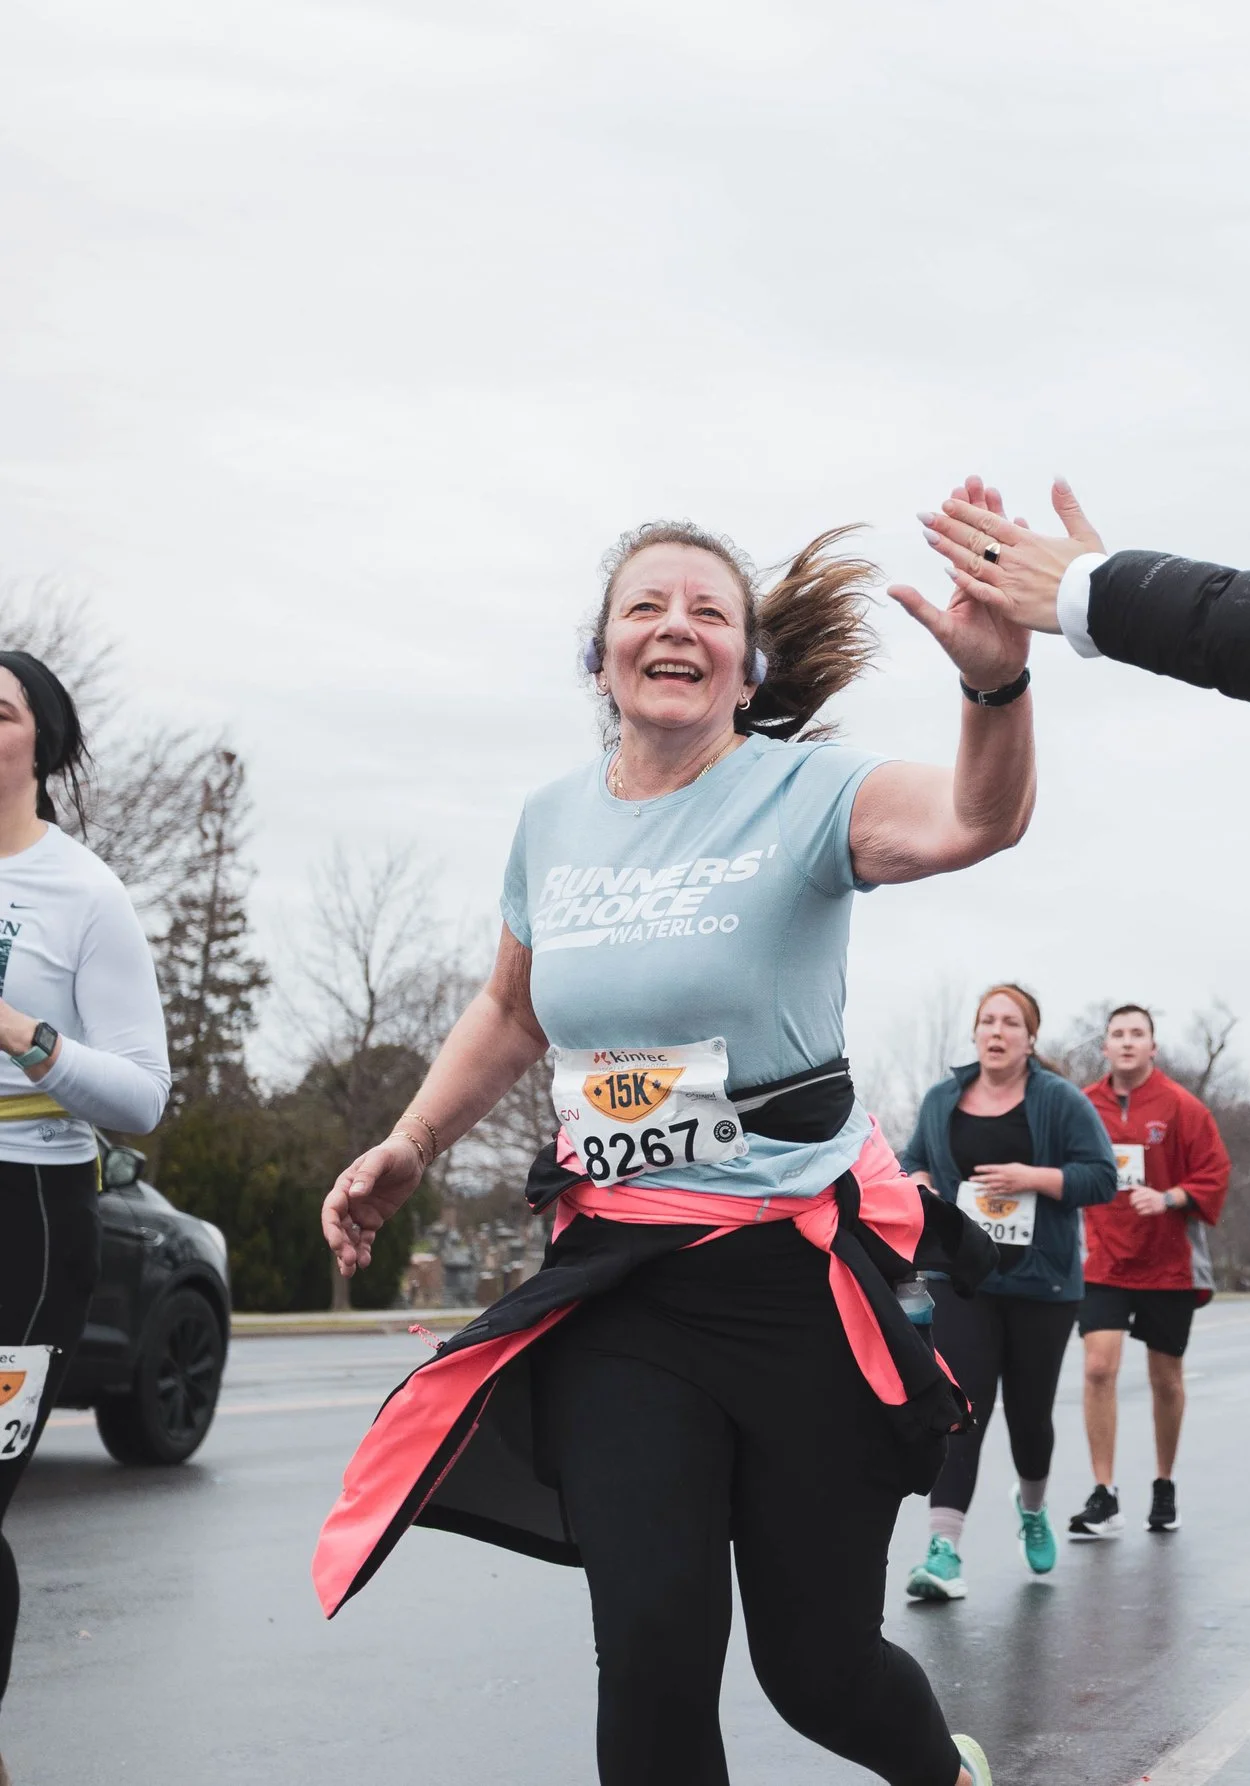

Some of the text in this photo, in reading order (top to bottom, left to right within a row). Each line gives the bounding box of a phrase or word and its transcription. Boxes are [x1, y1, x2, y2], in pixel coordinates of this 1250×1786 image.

[608, 913, 740, 945] WATERLOO
[609, 1051, 668, 1063] kintec
[605, 1072, 653, 1109] 15K
[583, 1118, 699, 1181] 8267
[980, 1222, 1016, 1240] 201
